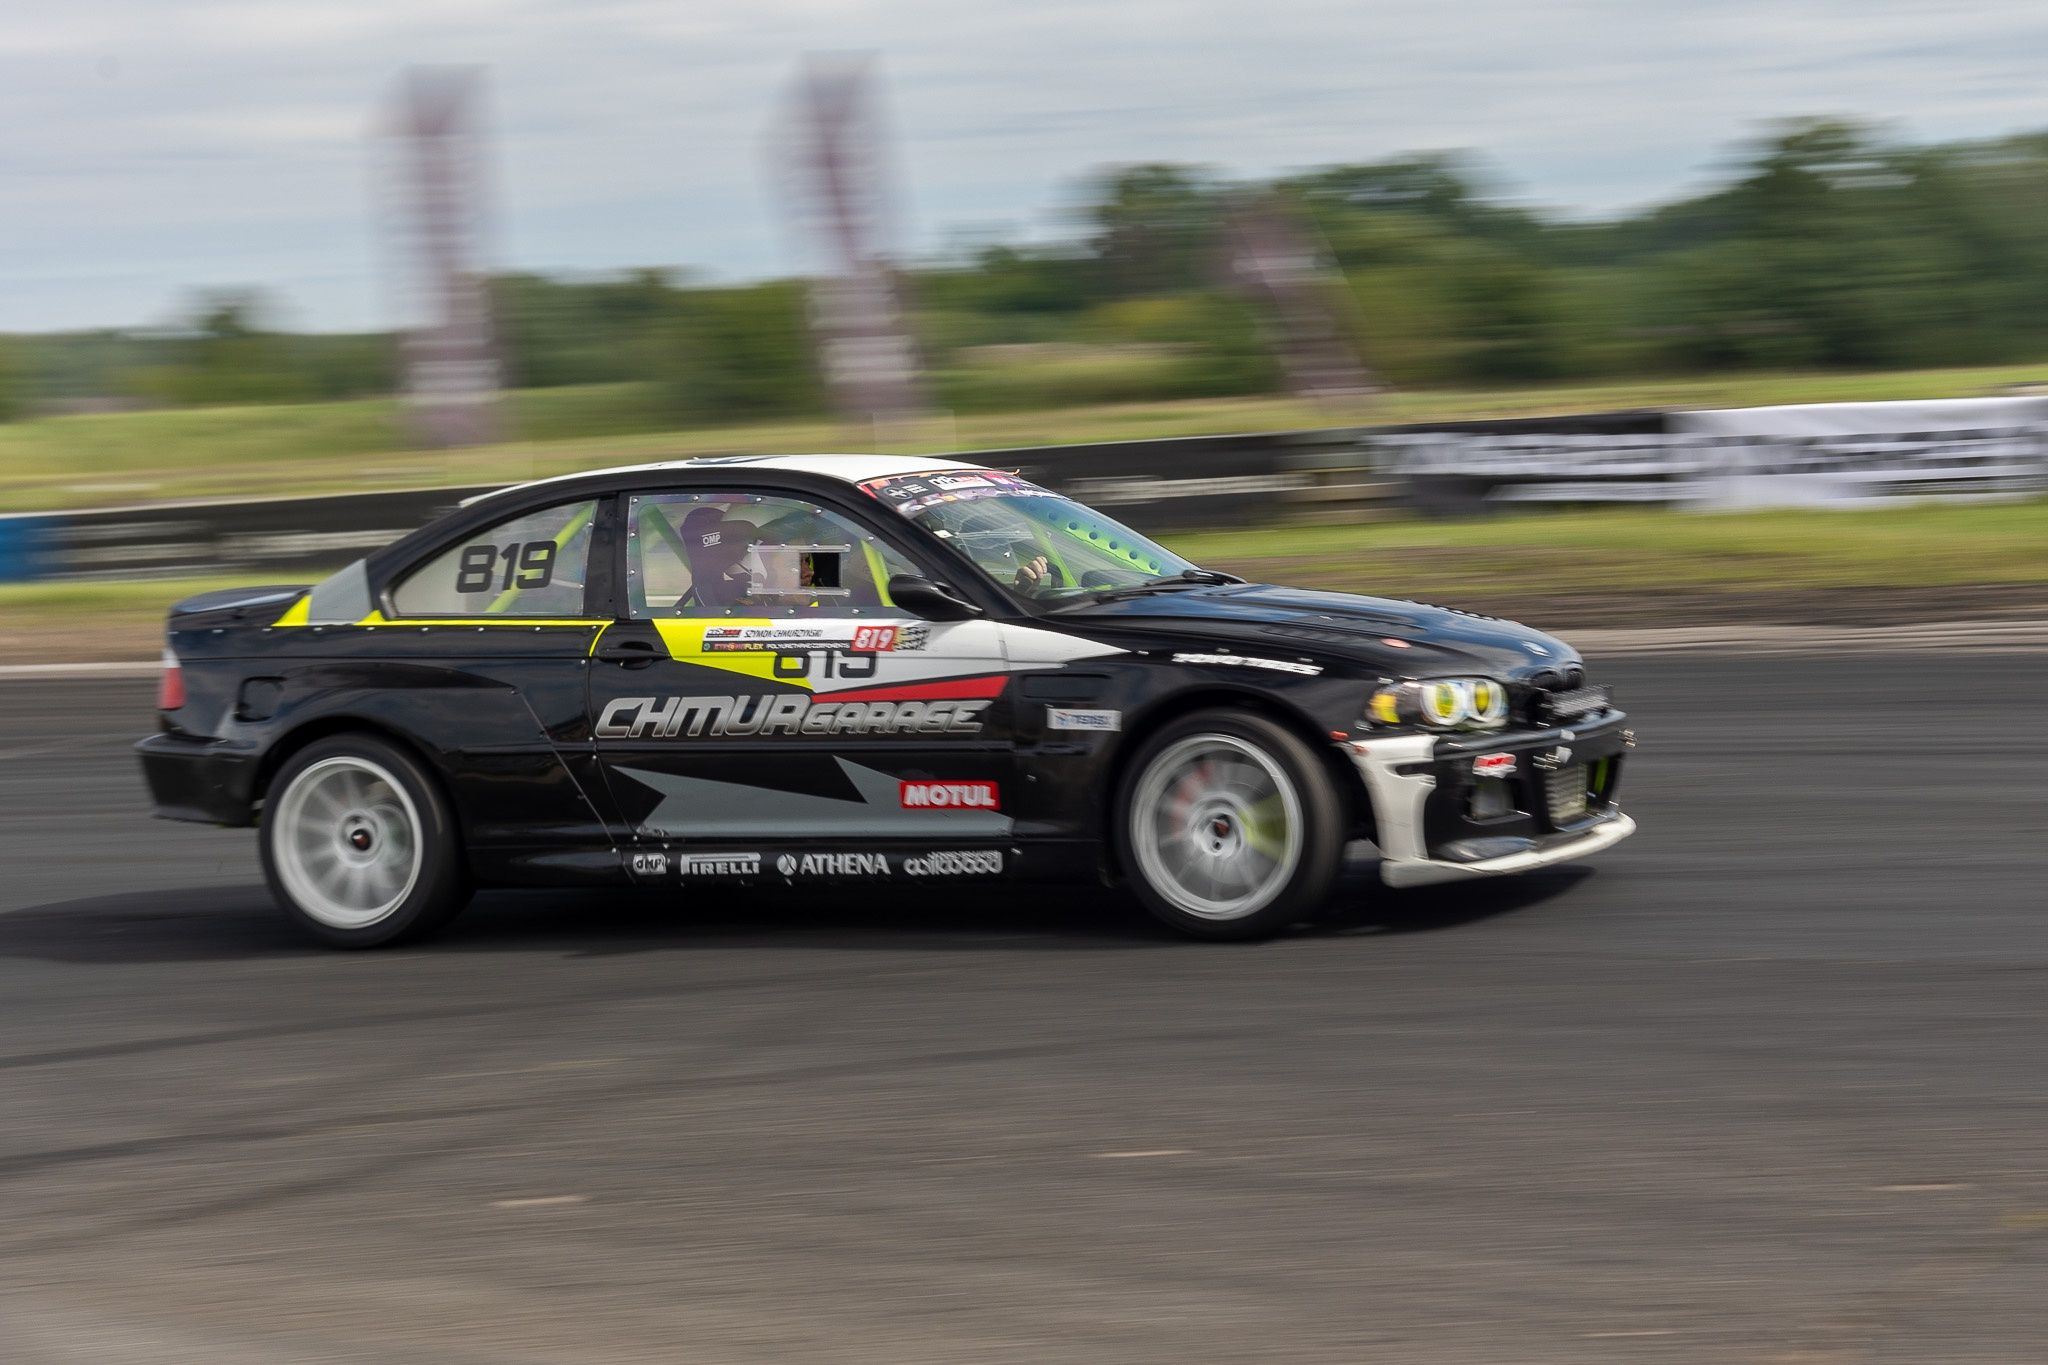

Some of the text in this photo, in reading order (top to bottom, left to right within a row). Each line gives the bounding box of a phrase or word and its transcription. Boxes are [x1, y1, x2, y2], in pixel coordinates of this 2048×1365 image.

[702, 533, 721, 545] OMP
[456, 540, 558, 594] 819
[855, 628, 893, 649] 819
[596, 695, 993, 738] CHMUR GARAGE
[905, 785, 996, 806] MOTUL
[681, 853, 761, 875] PIRELLI
[800, 853, 891, 875] ATHENA
